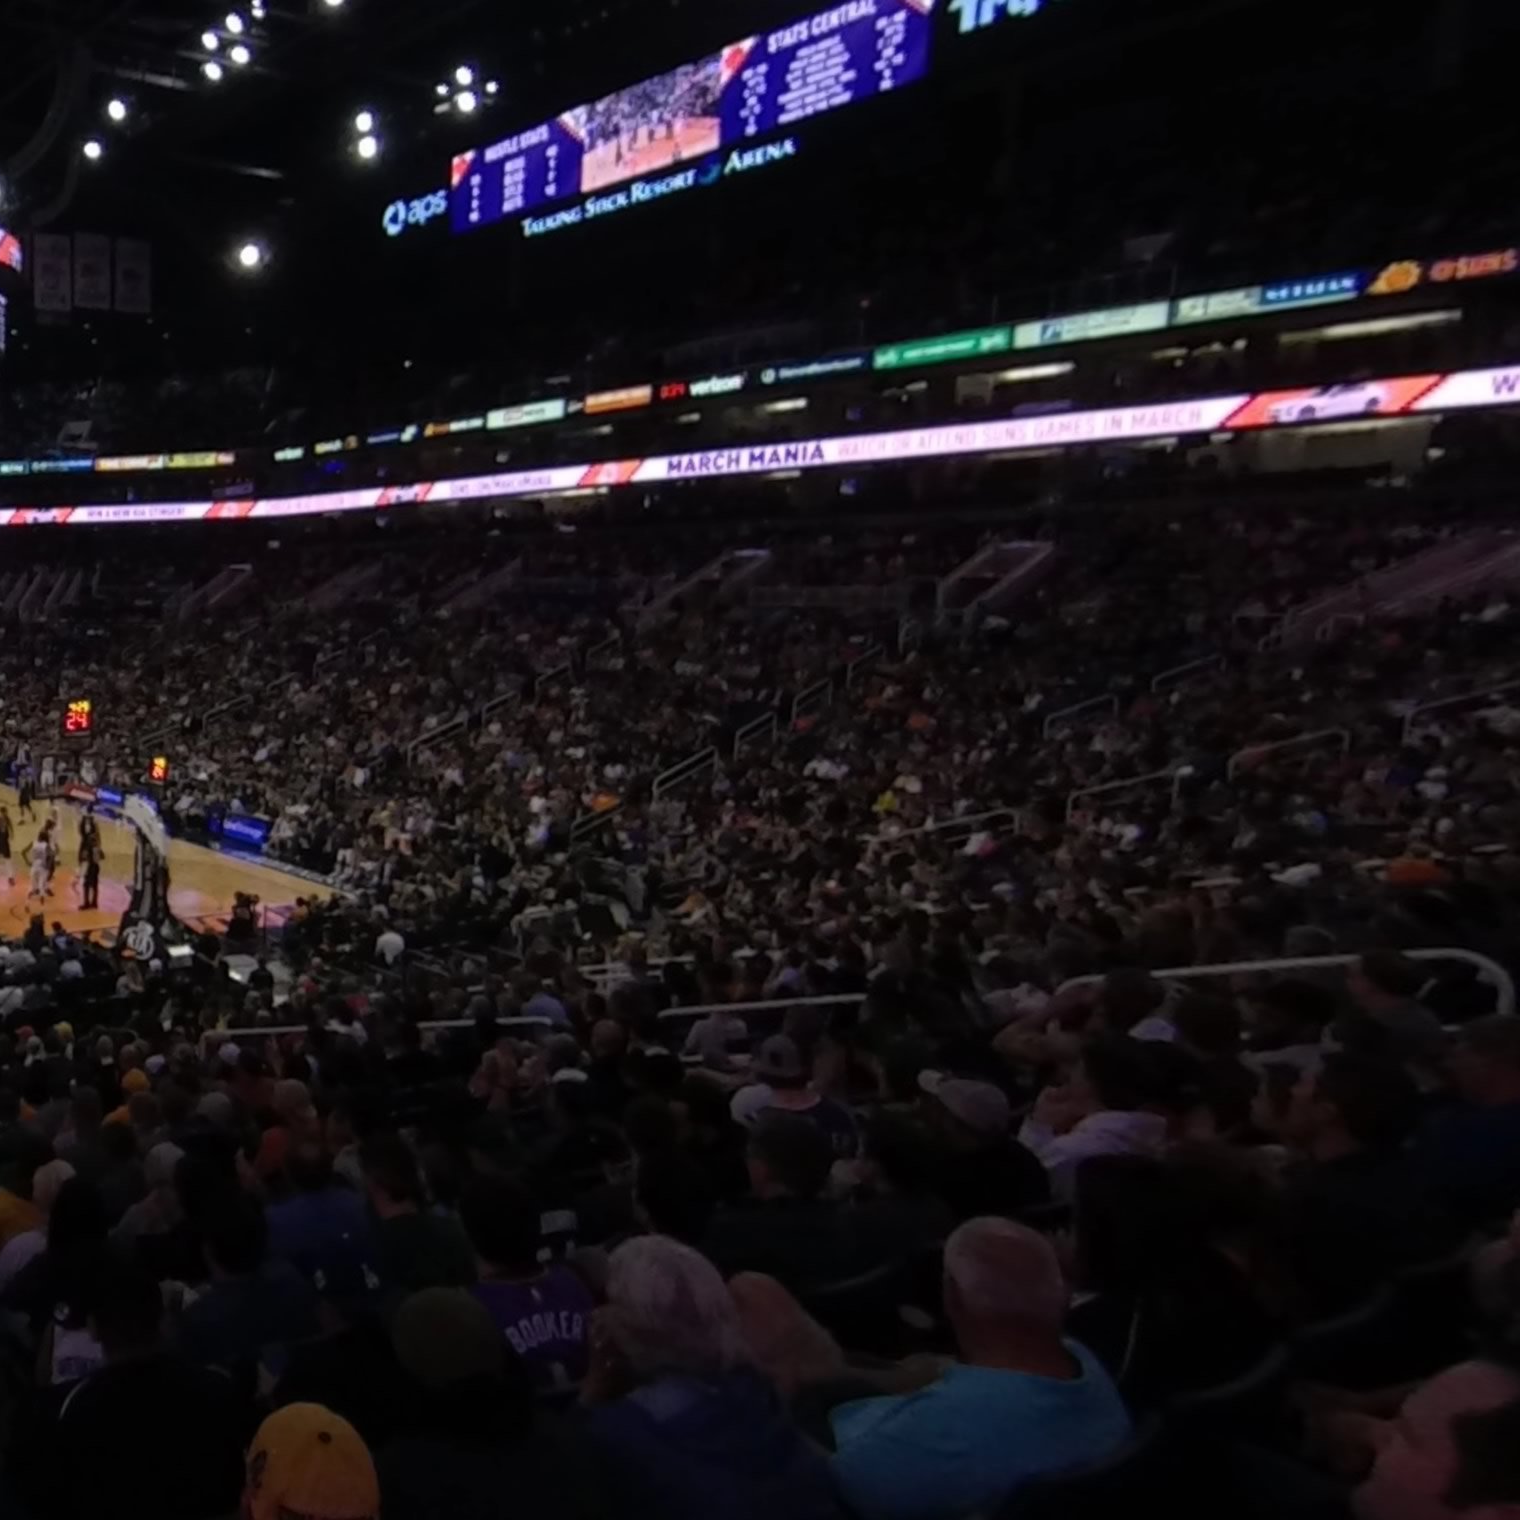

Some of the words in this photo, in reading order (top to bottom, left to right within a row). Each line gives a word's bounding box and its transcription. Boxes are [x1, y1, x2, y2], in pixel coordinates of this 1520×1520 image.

[768, 21, 808, 53] STATS
[811, 0, 876, 36] CENTRAL
[521, 124, 549, 149] STATS
[408, 189, 449, 225] aps
[690, 374, 744, 397] verizon
[667, 453, 742, 475] MARCH
[748, 444, 824, 471] MANIA
[917, 430, 976, 450] ATTEND
[983, 426, 1027, 444] SUNS
[1033, 419, 1095, 439] GAMES
[1102, 415, 1123, 431] IN
[1130, 410, 1201, 430] MARCH
[67, 713, 87, 730] 24
[504, 1310, 584, 1354] BOOKER
